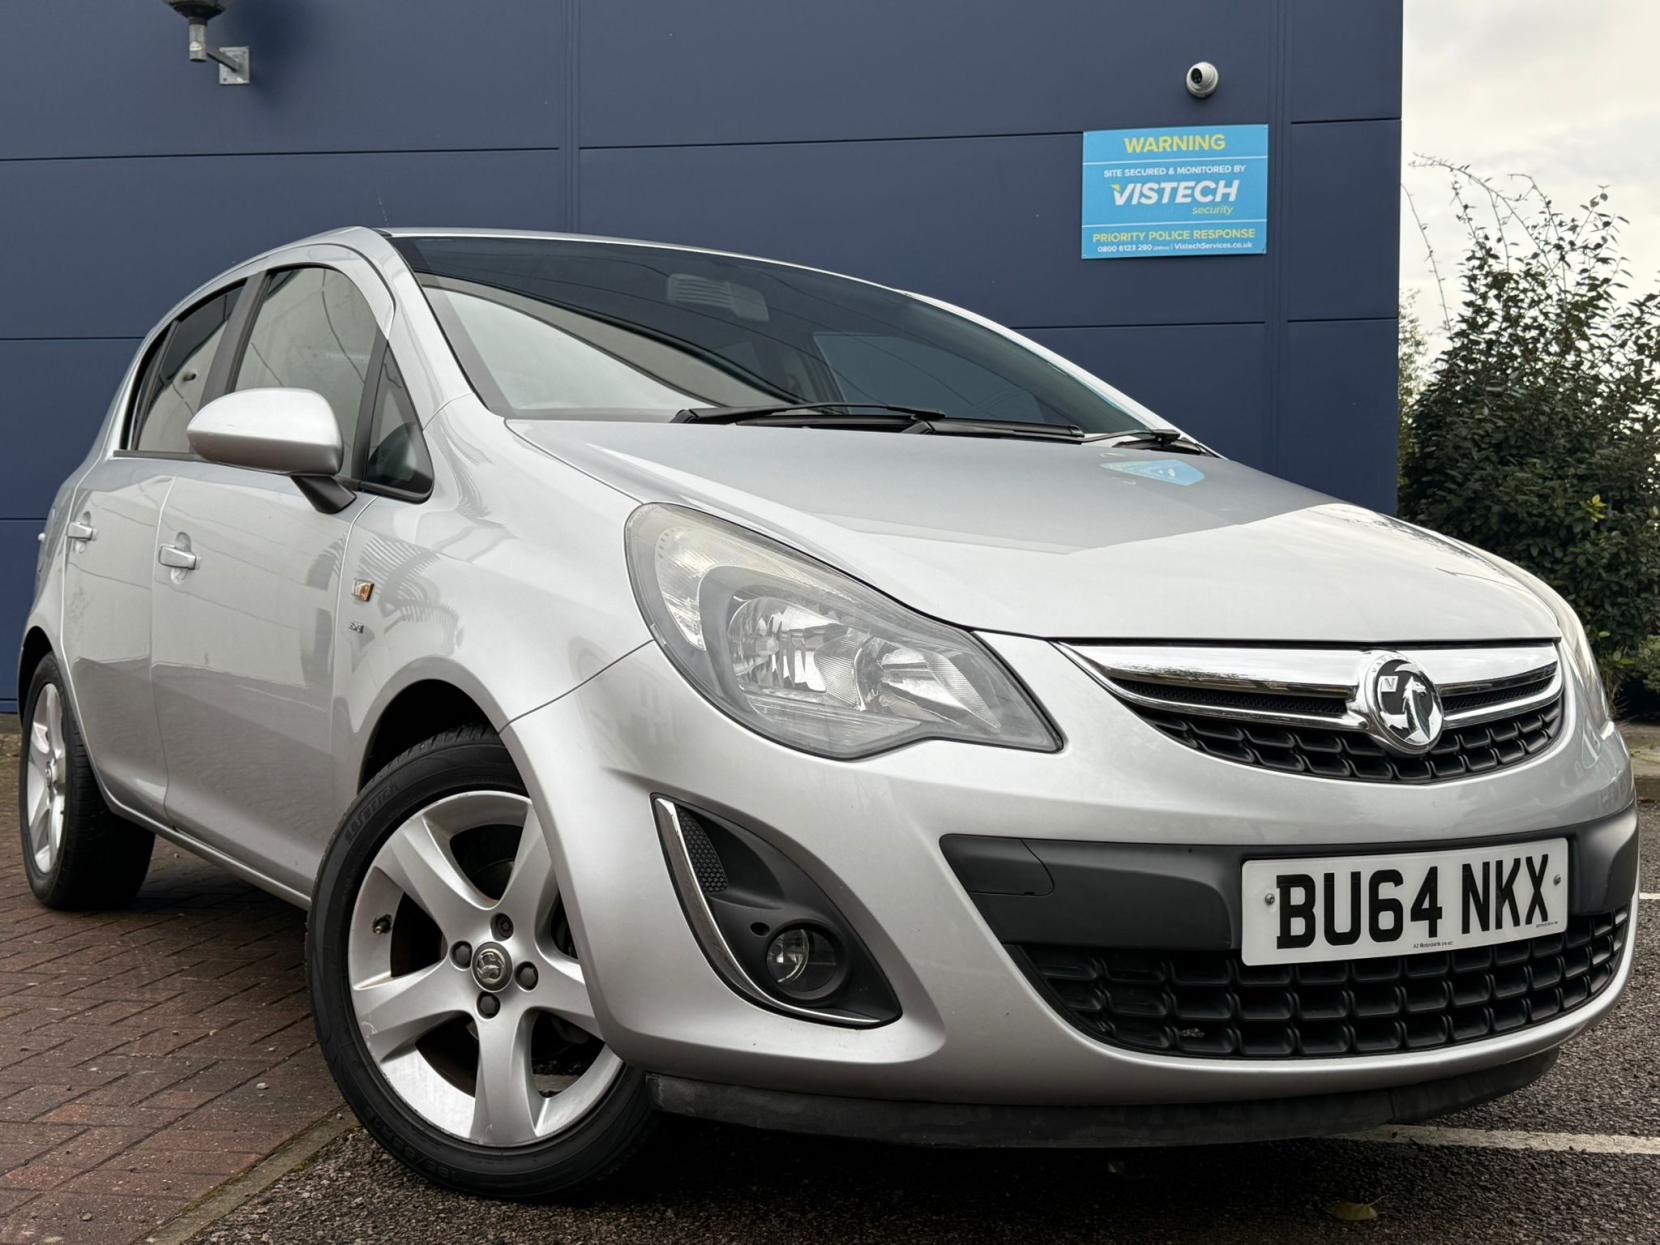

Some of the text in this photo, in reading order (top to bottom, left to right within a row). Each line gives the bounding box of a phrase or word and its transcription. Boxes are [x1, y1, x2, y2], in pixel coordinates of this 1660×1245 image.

[1123, 133, 1226, 154] WARNING
[1104, 164, 1246, 178] SITE SECURED & MONITORED BY
[1111, 179, 1240, 206] VISTECH
[1192, 205, 1234, 216] security
[1093, 228, 1256, 243] PRIORITY POLICE RESPONSE
[1097, 244, 1117, 253] 0800
[1174, 241, 1253, 251] VistechServices.co.uk
[1276, 853, 1549, 950] BU64 NKX
